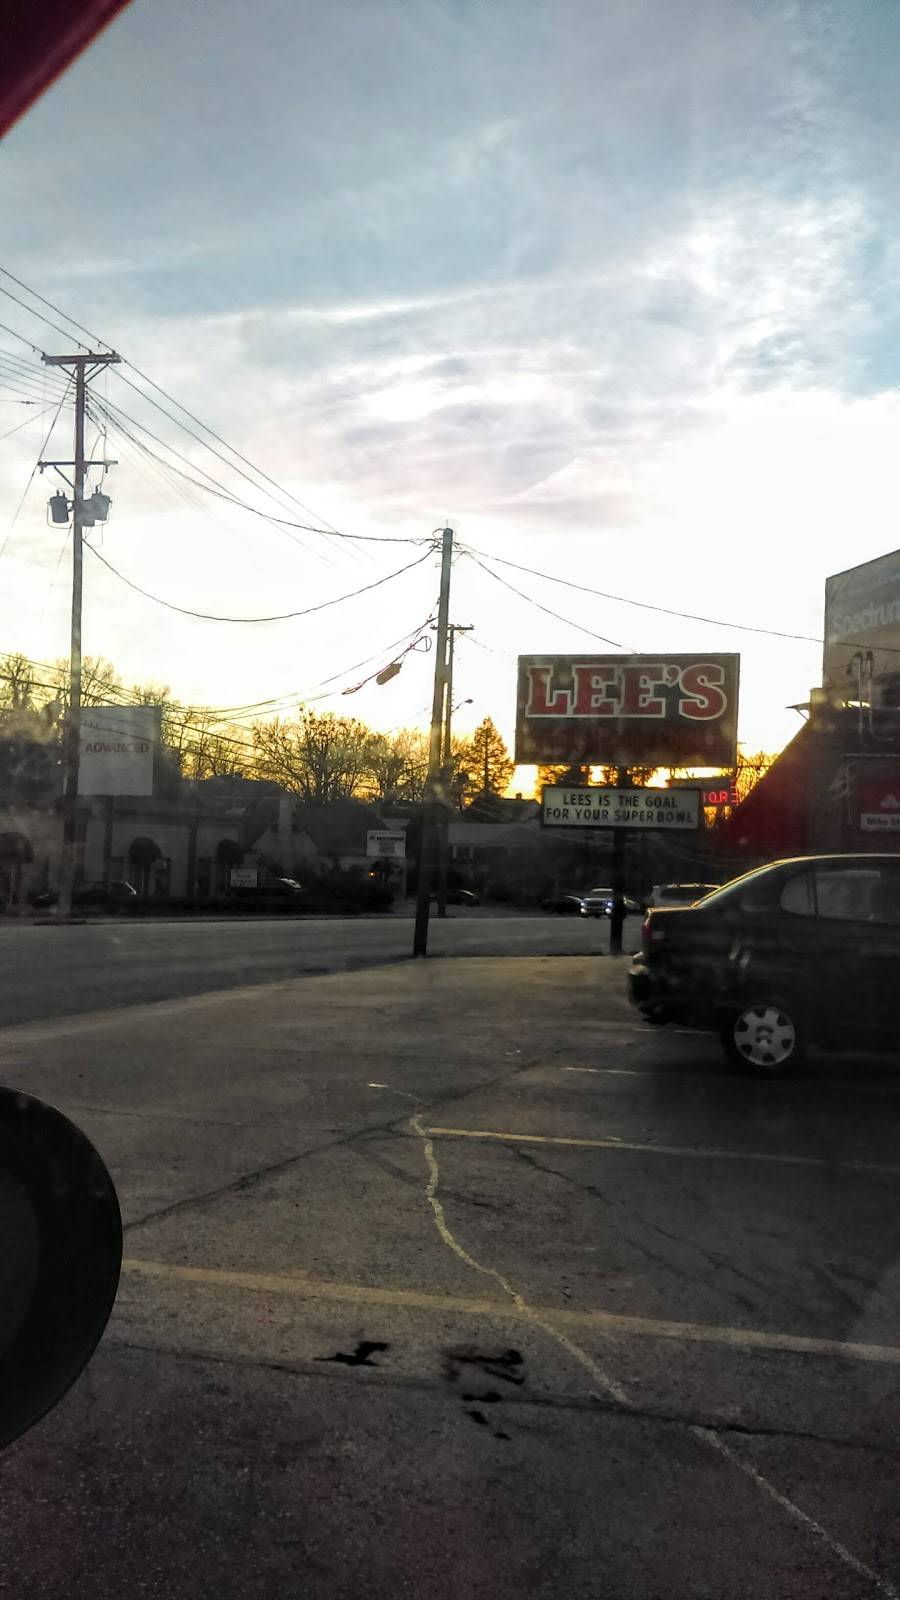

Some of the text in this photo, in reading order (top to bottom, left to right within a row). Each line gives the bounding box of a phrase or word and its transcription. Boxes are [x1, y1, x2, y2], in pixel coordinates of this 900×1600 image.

[525, 663, 728, 720] LEE'S
[563, 793, 679, 808] LEES IS THE GOAL
[546, 807, 569, 819] FOR
[575, 808, 609, 821] YOUR
